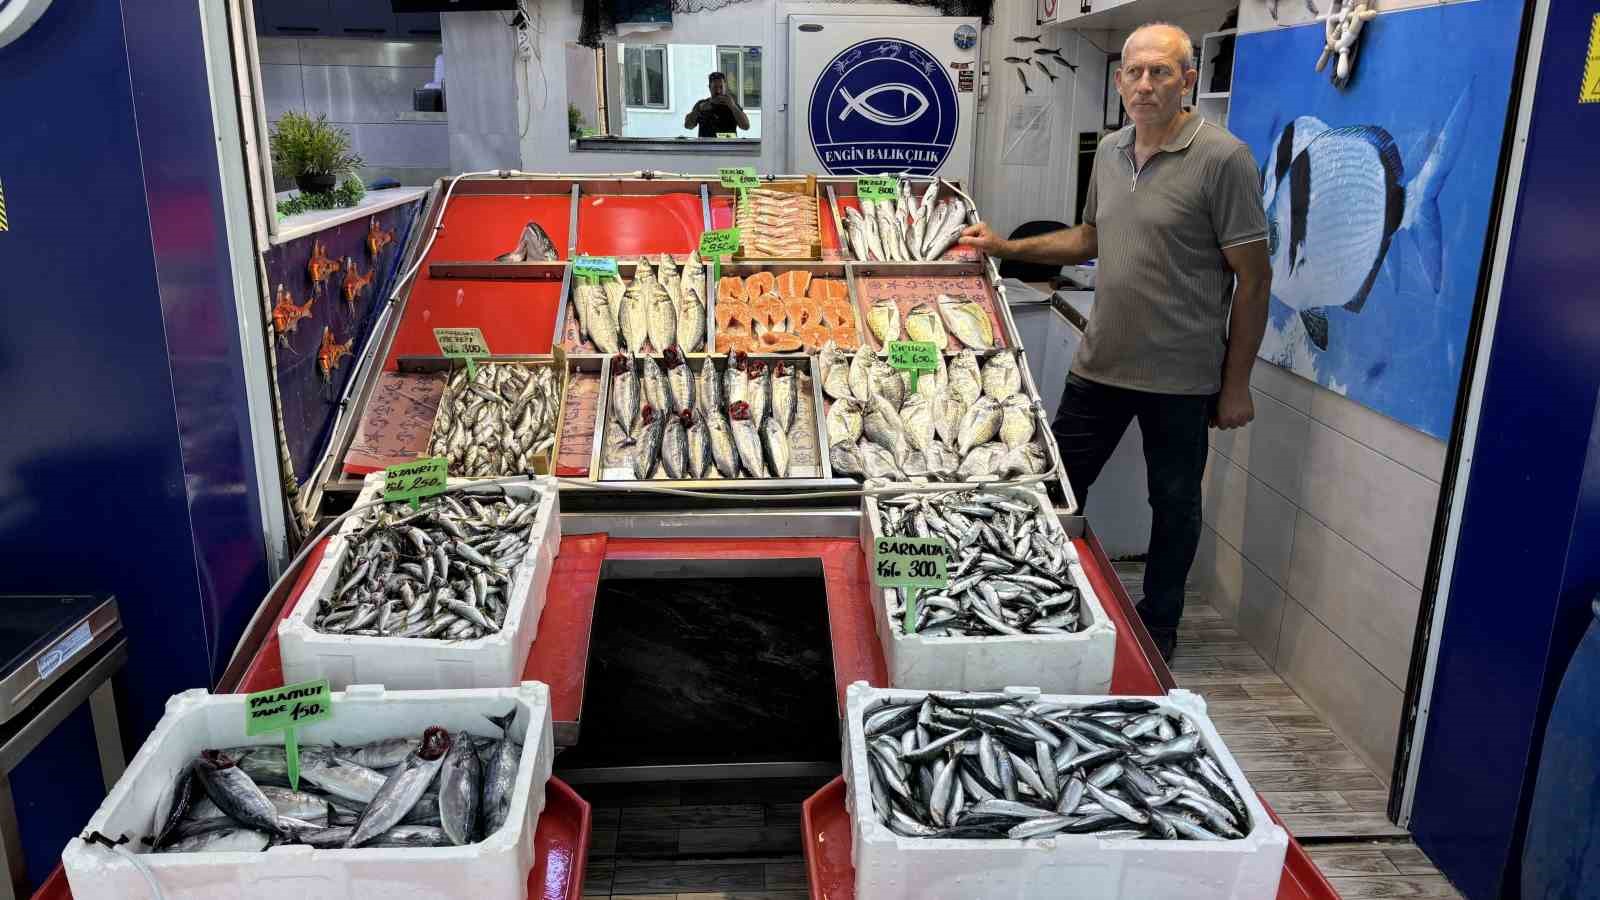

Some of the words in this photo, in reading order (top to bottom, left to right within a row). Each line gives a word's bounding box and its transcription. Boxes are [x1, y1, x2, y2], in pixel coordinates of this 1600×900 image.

[825, 146, 864, 162] ENGİN
[866, 148, 939, 164] BALIKÇILIK
[250, 686, 323, 708] PALAMUT
[252, 704, 288, 718] TANE
